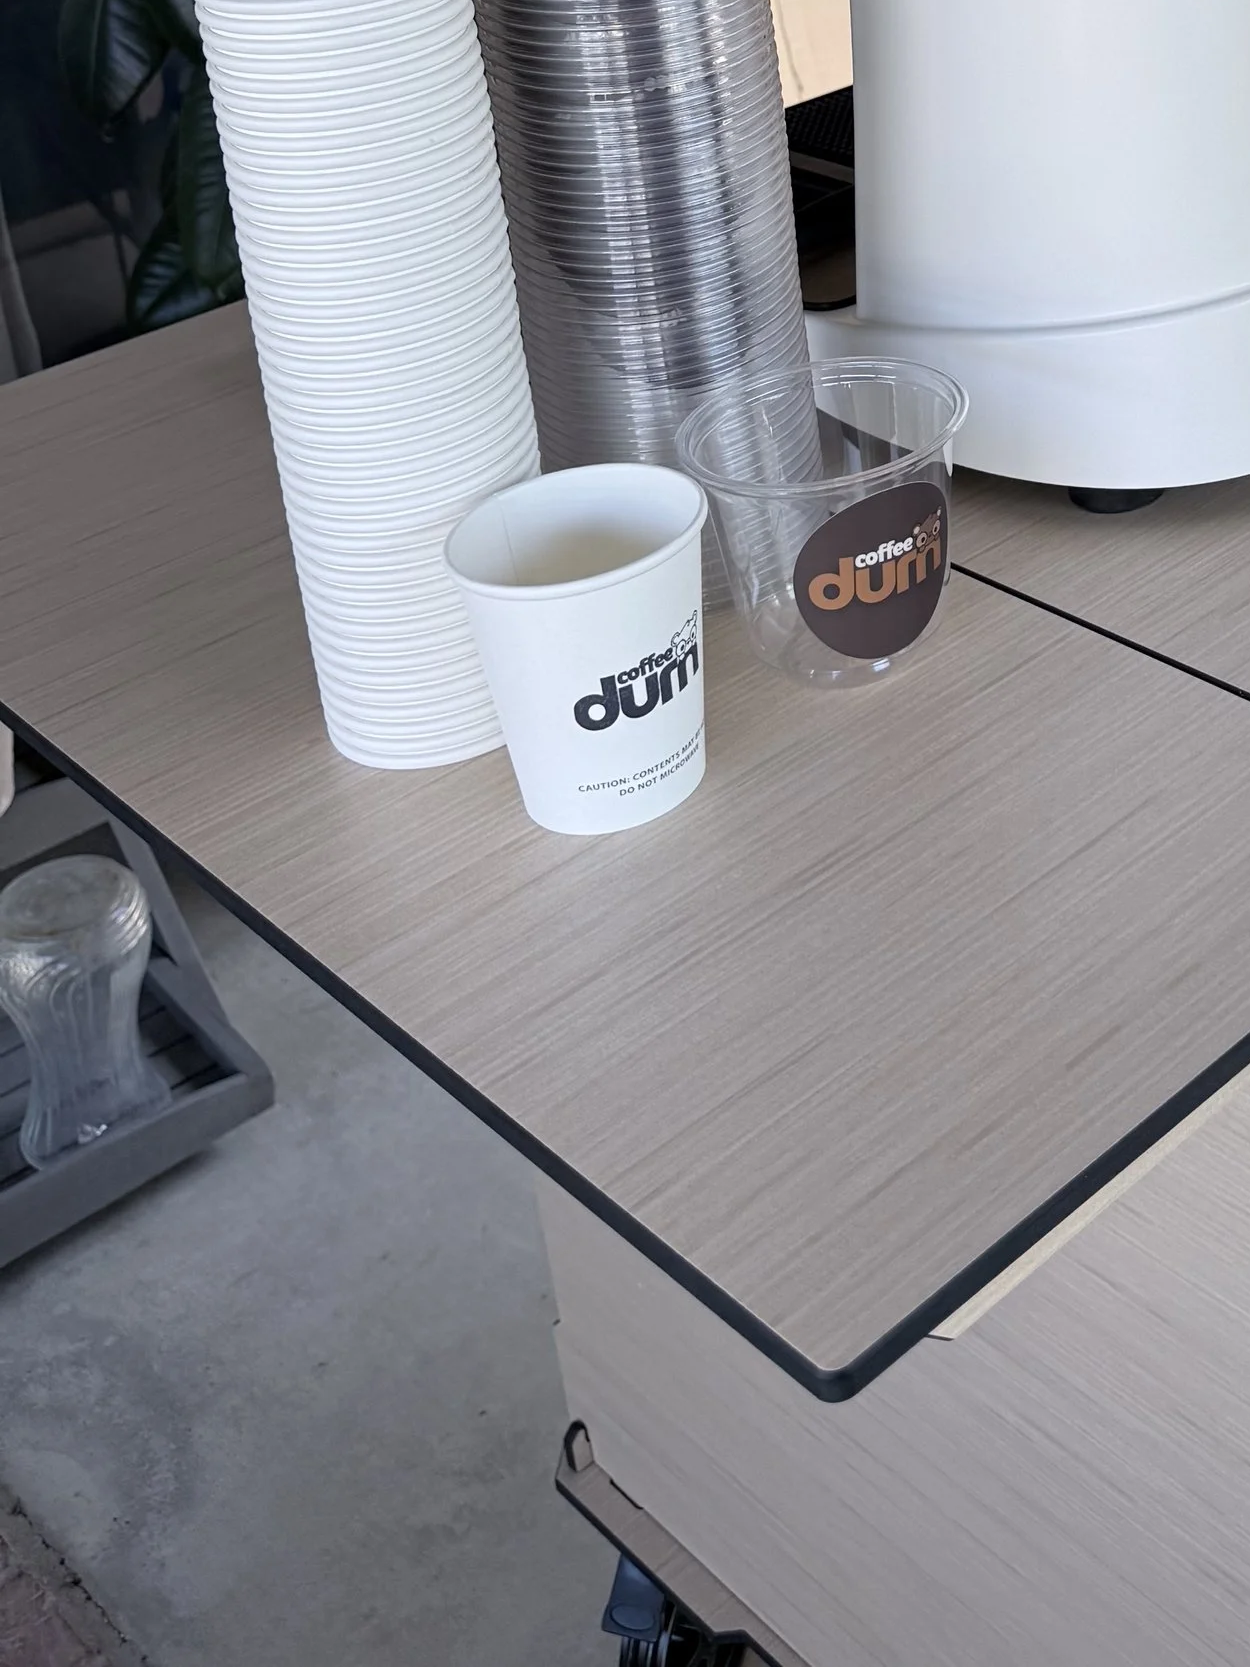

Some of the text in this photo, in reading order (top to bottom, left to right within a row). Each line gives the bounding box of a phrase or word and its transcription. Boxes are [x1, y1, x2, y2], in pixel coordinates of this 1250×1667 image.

[855, 536, 913, 568] coffee
[617, 646, 673, 684] coffee
[578, 777, 631, 793] CAUTION:
[632, 750, 680, 781] CONTENTS
[619, 741, 699, 796] DO NOT MICROWAVE
